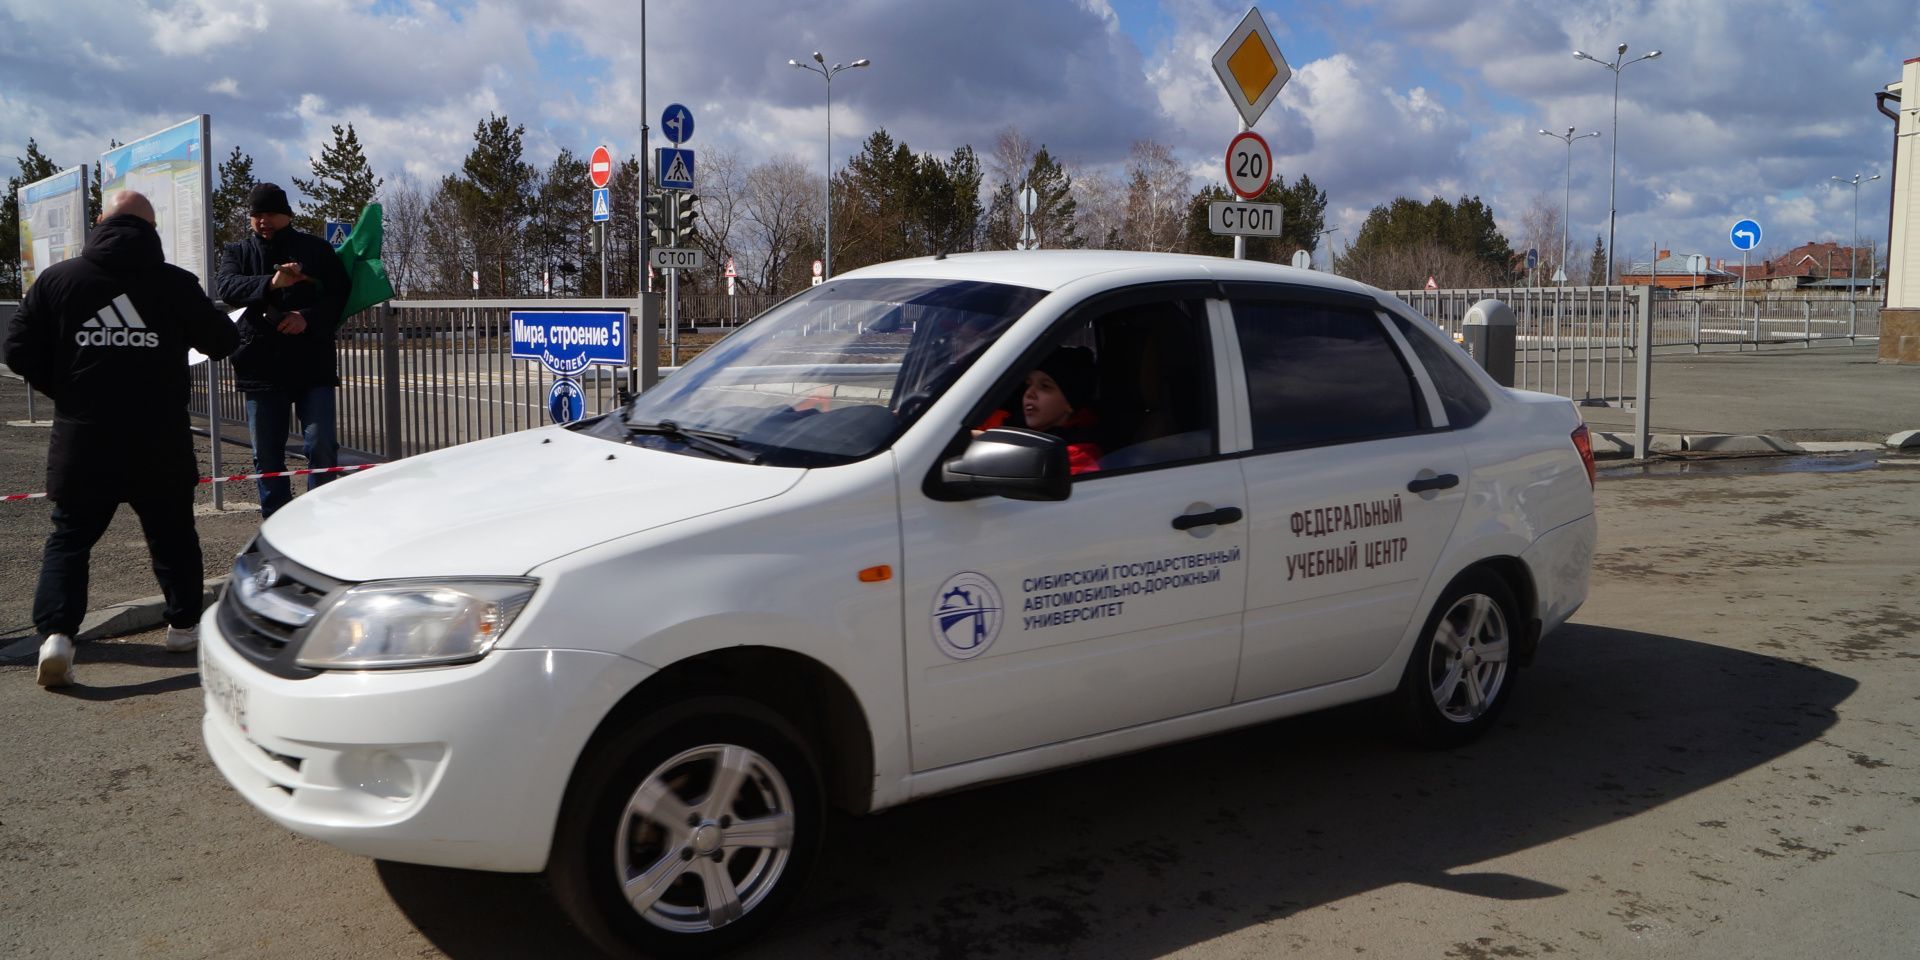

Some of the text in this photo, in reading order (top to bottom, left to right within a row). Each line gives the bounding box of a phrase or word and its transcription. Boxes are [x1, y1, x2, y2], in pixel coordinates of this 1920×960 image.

[1236, 152, 1262, 178] 20
[1222, 206, 1273, 230] СТОП
[658, 251, 696, 265] СТОП
[75, 327, 160, 348] adidas
[514, 319, 621, 350] Мира, строение 5
[543, 349, 587, 371] ПРОСПЕКТ
[561, 396, 570, 423] 8
[1290, 493, 1403, 538] ФЕДЕРАЛЬНЫЙ
[1022, 546, 1241, 592] СИБИРСКИЙ ГОСУДАРСТВЕННЫЙ
[1286, 537, 1408, 581] УЧЕБНЫЙ ЦЕНТР
[1023, 566, 1220, 612] АВТОМОБИЛЬНО-ДОРОЖНЫЙ
[1023, 602, 1124, 631] УНИВЕРСИТЕТ
